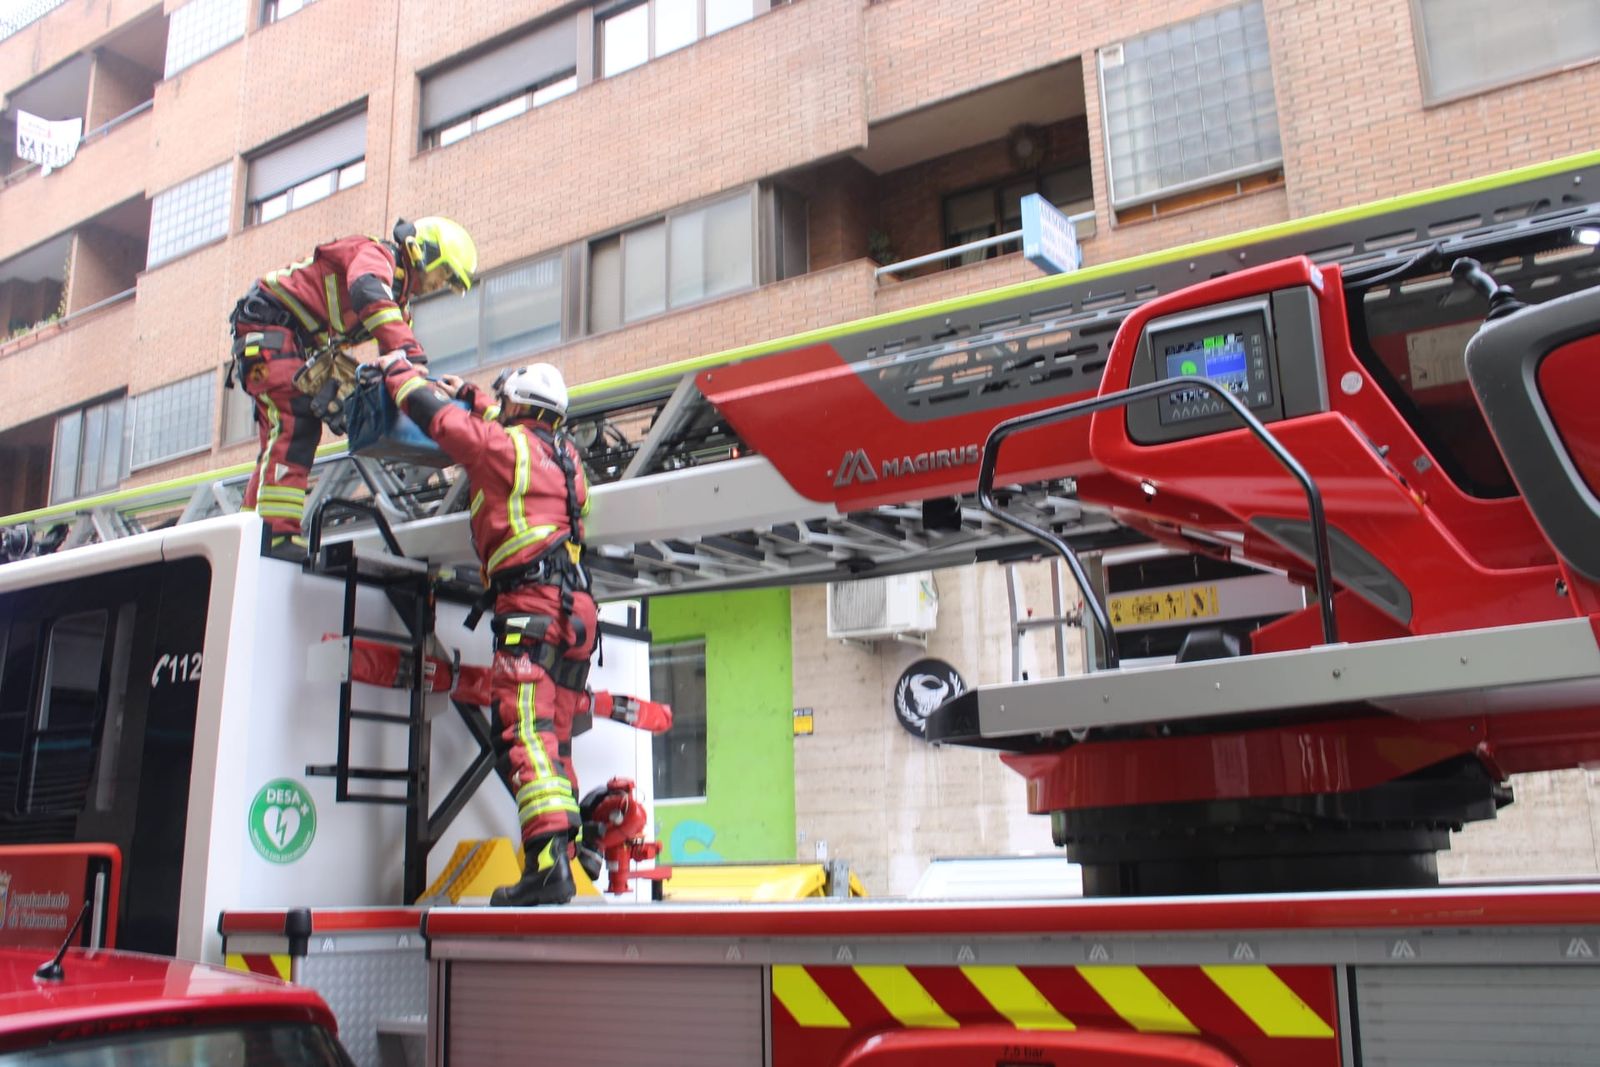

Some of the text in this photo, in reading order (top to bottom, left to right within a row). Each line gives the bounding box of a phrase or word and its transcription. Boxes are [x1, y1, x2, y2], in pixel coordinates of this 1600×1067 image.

[882, 444, 978, 477] MAGIRUS
[169, 652, 202, 682] 112
[267, 788, 300, 806] DESA
